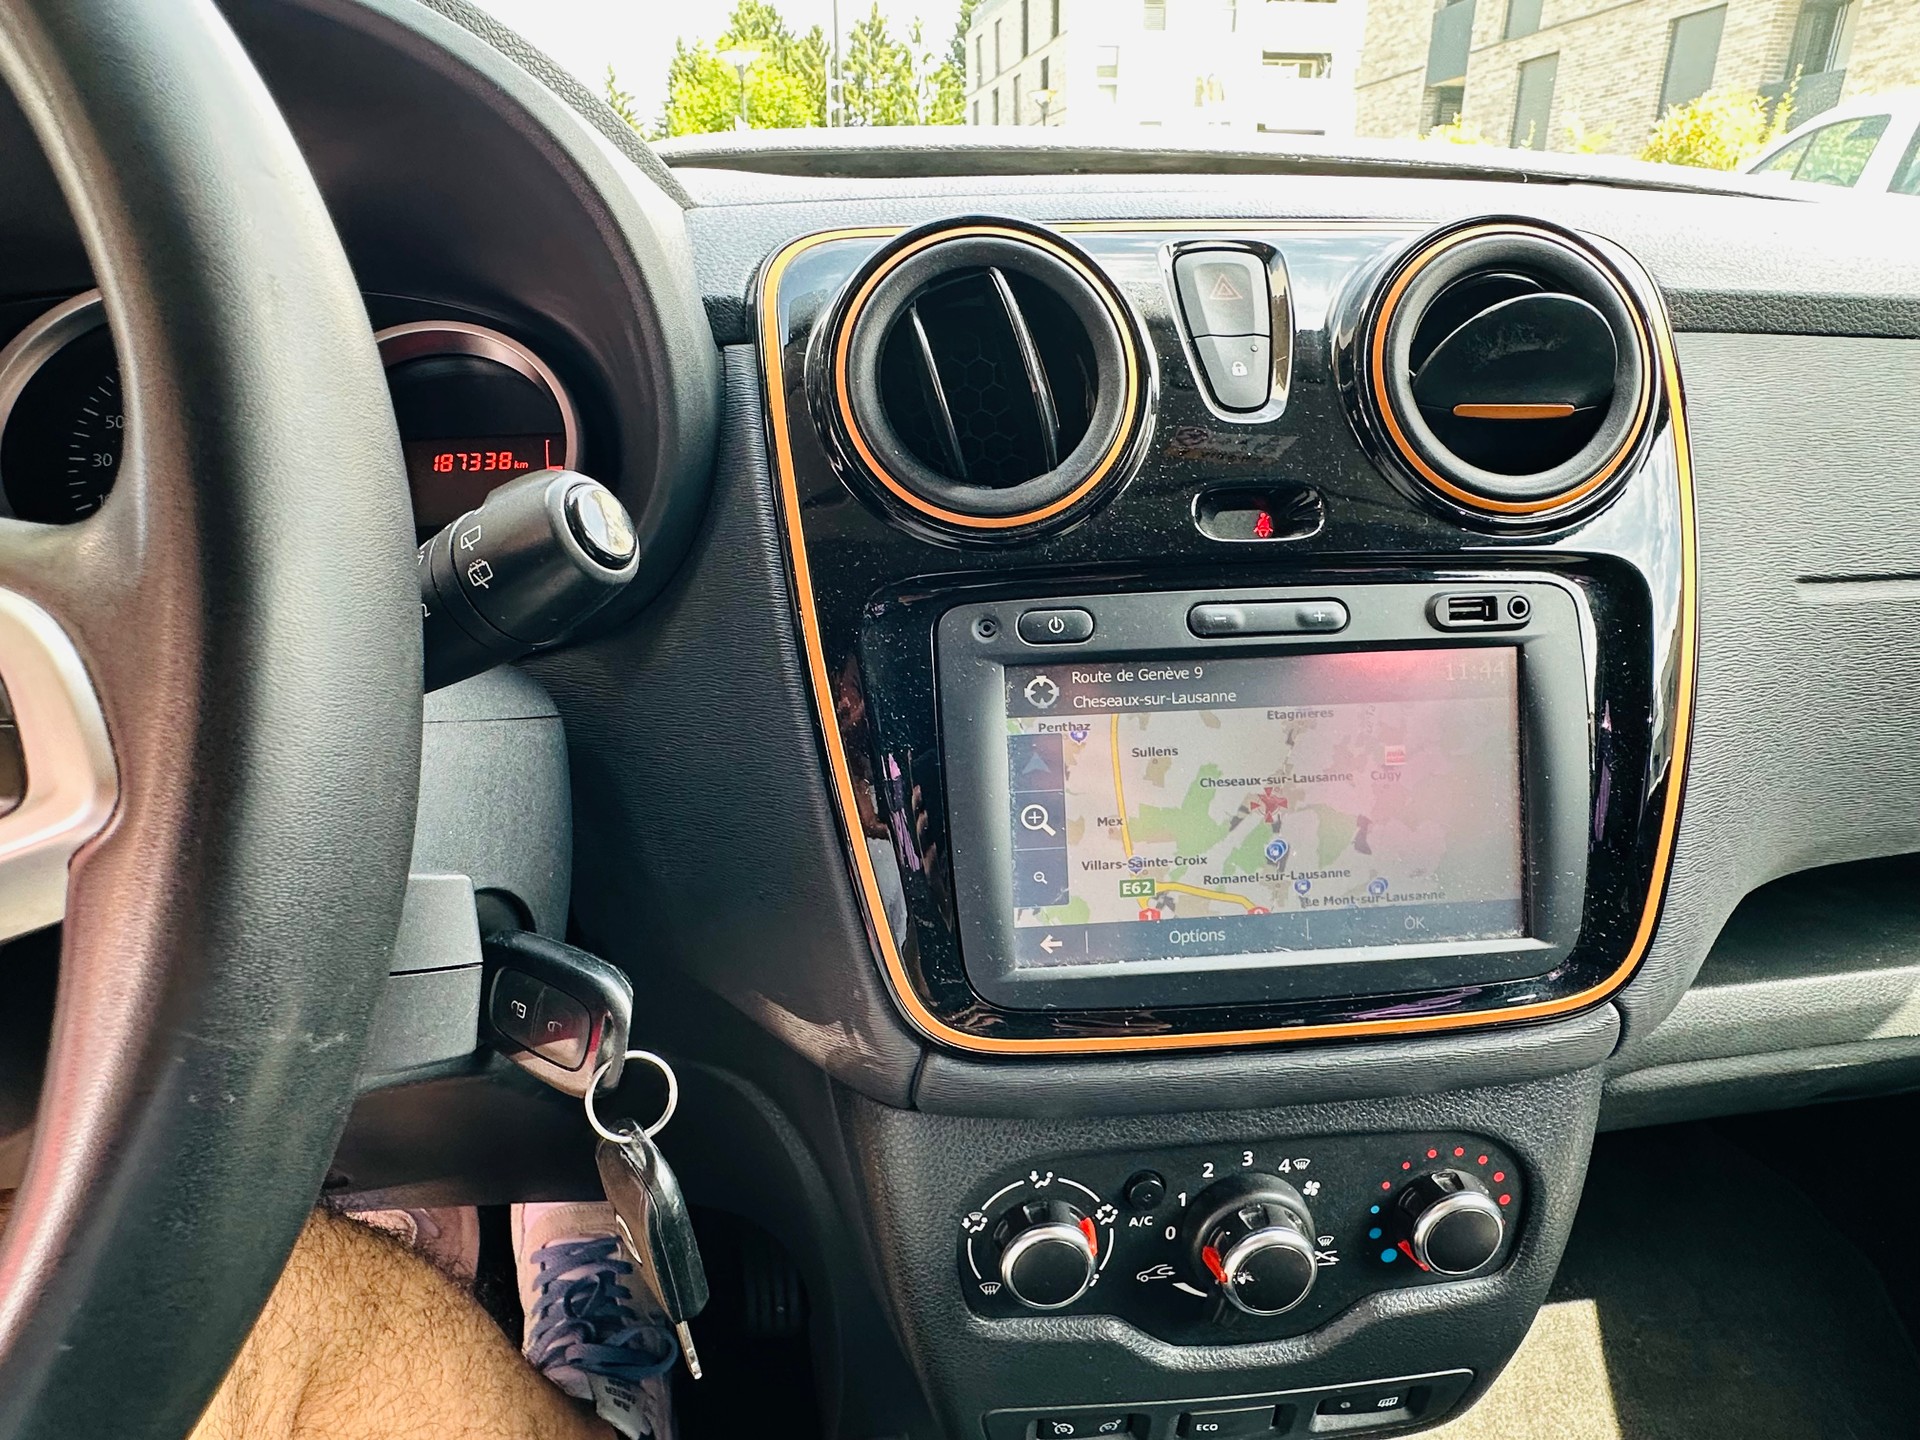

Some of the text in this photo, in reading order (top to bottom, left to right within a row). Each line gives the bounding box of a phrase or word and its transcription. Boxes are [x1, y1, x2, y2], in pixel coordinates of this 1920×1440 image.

[105, 415, 124, 429] 50
[92, 453, 113, 467] 30
[433, 452, 529, 472] 187338 km
[1072, 666, 1204, 684] Route de Genève 9
[1446, 661, 1506, 681] 11:44
[1073, 690, 1237, 709] Cheseaux-sur-Lausanne
[1038, 721, 1091, 733] Penthaz
[1131, 746, 1179, 759] Sullens
[1200, 772, 1353, 788] Cheseaux-sur-Lausanne
[1370, 769, 1402, 782] Cugy
[1097, 816, 1123, 828] Mex
[1081, 855, 1208, 871] Villars-Sainte-Croix
[1203, 869, 1351, 885] Romanel-sur-Lausanne
[1122, 881, 1152, 896] E62
[1323, 890, 1446, 906] Mont-sur-Lausanne
[1404, 917, 1426, 930] OK
[1169, 929, 1226, 946] Options
[1242, 1151, 1254, 1166] 3
[1202, 1163, 1214, 1178] 2
[1278, 1159, 1291, 1174] 4
[1177, 1192, 1187, 1207] 1
[1129, 1216, 1153, 1228] A/C
[1165, 1226, 1177, 1240] 0
[1196, 1423, 1219, 1431] ECO
